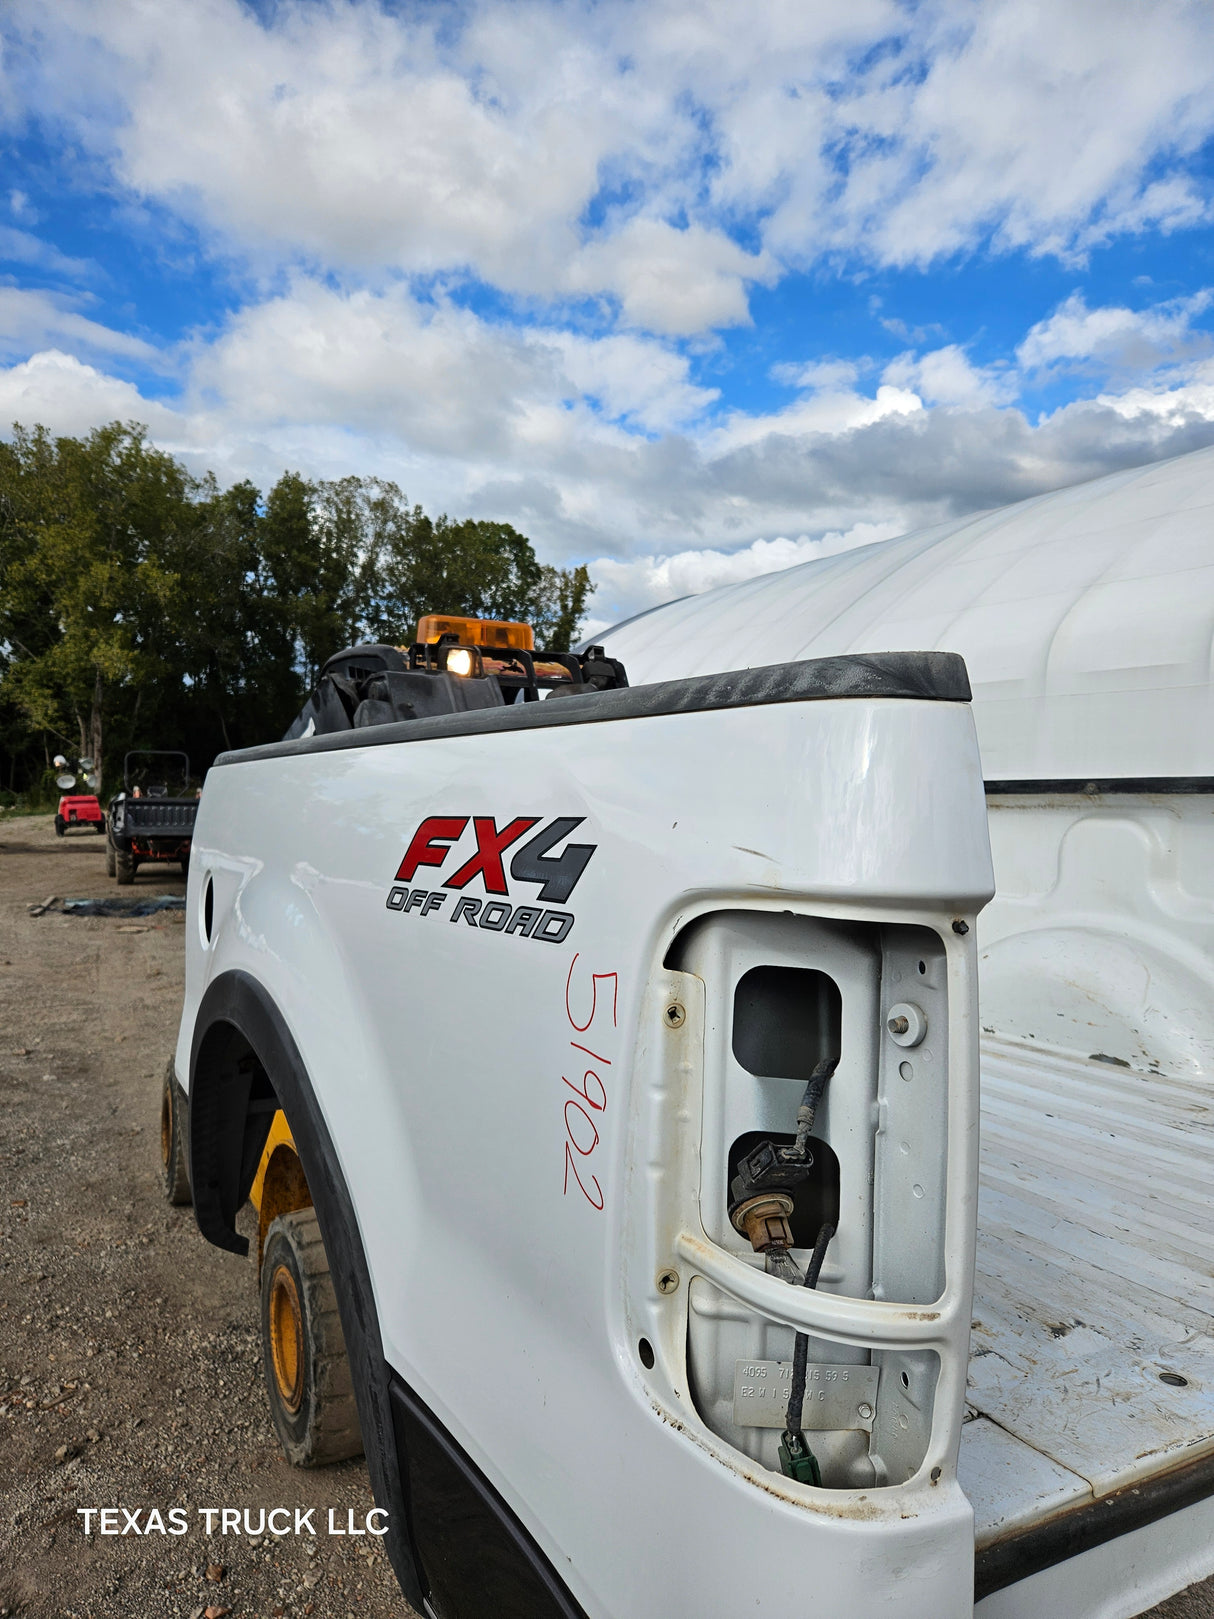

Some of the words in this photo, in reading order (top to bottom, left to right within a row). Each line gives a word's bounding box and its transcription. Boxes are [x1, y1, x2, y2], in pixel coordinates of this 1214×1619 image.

[393, 815, 599, 905] FX4
[386, 886, 447, 917] OFF
[450, 896, 575, 944] ROAD
[562, 952, 618, 1211] 51902
